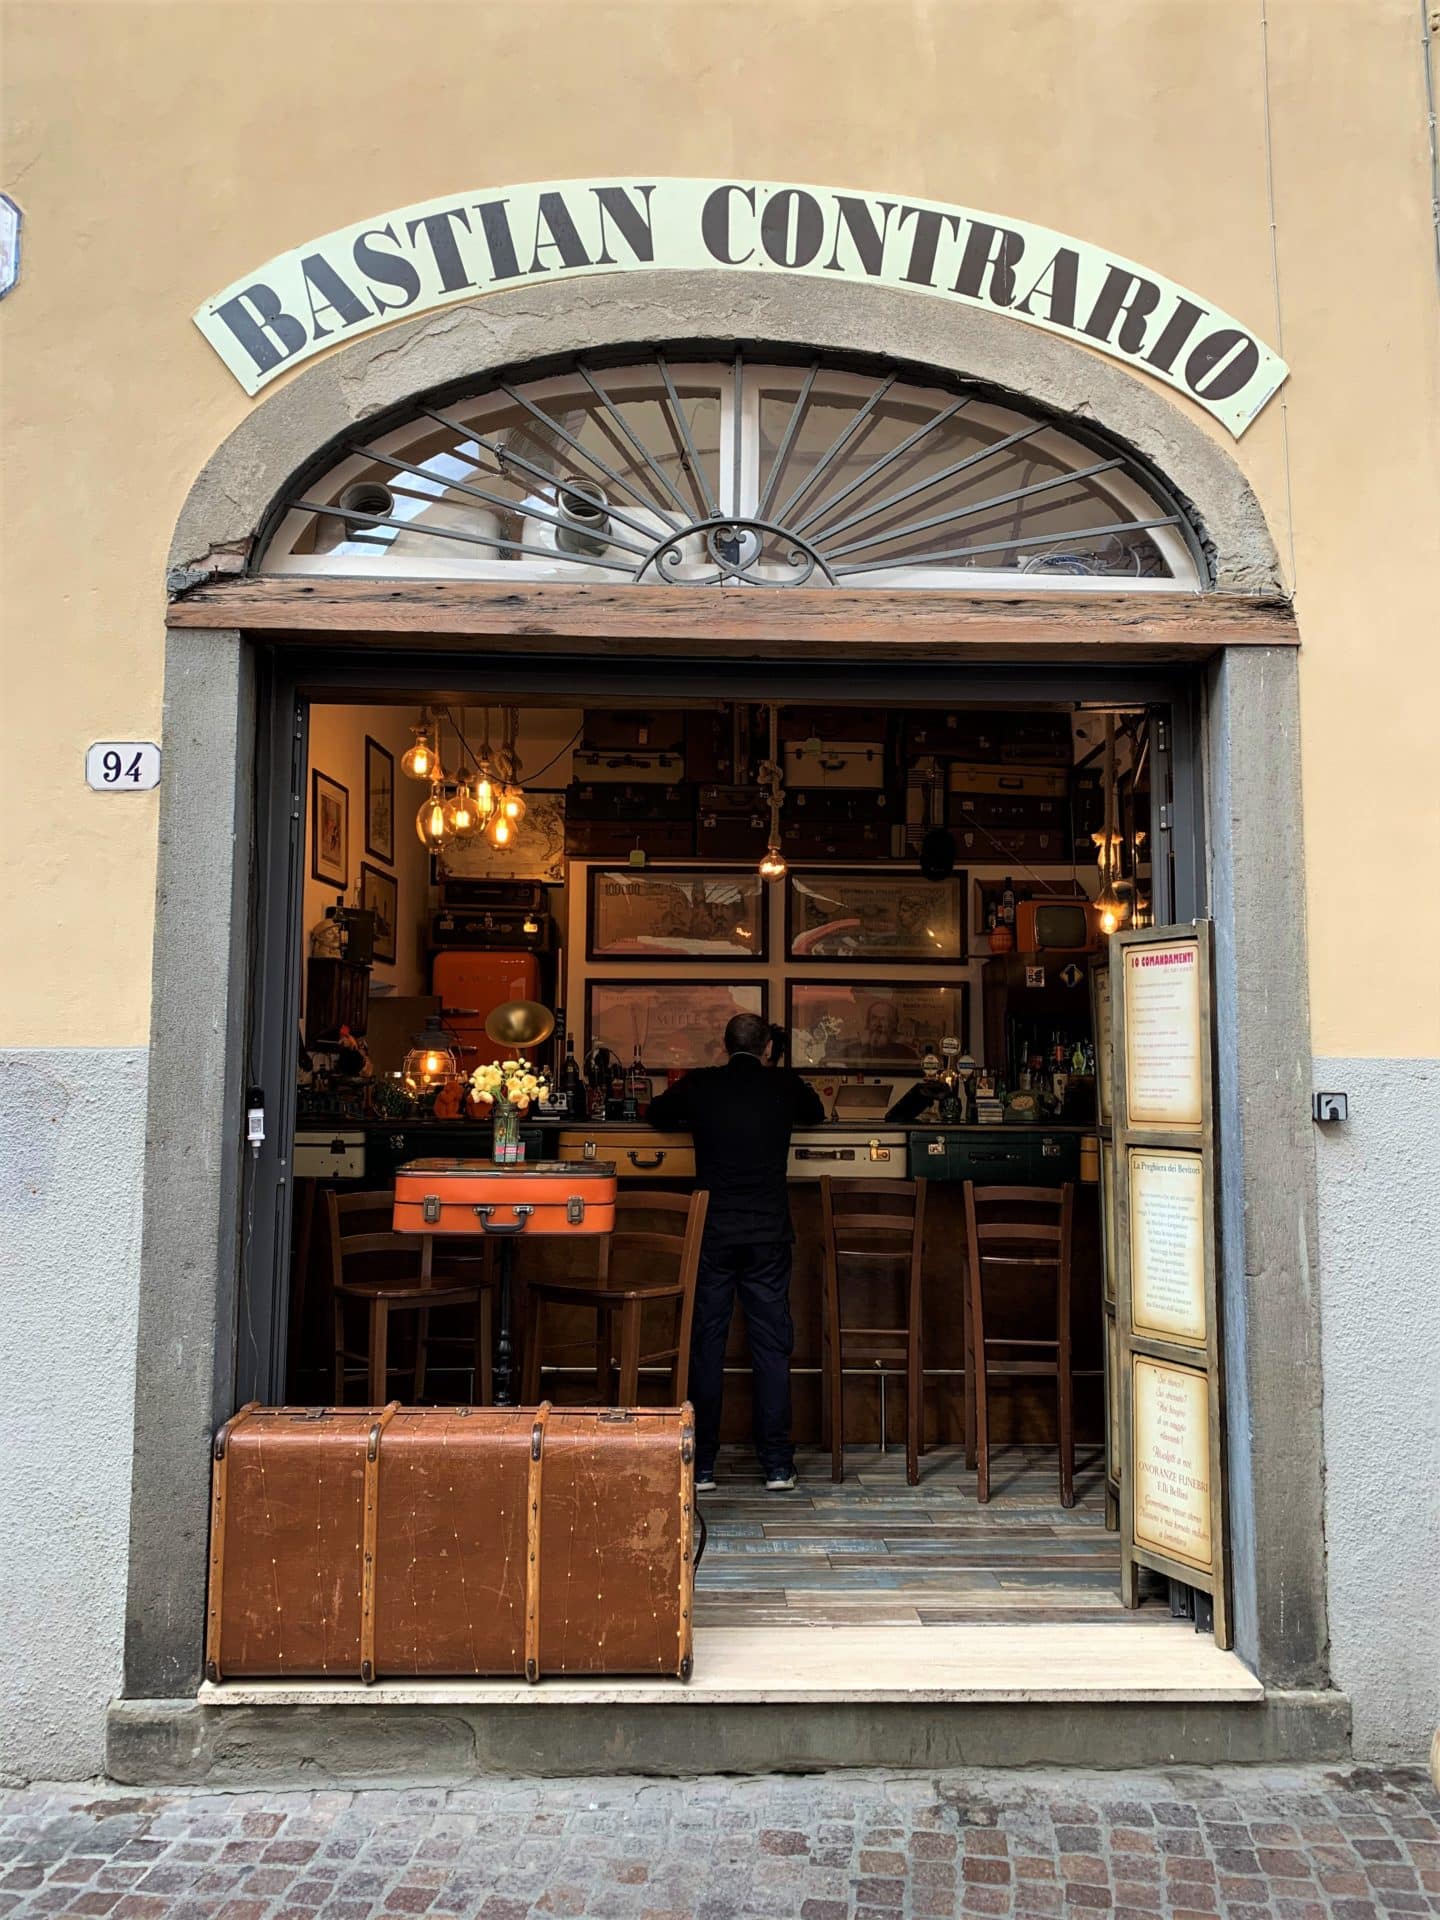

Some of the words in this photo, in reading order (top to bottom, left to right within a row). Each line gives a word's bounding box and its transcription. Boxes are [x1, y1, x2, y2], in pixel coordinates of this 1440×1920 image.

[209, 185, 657, 378] BASTIAN
[701, 184, 1260, 401] CONTRARIO
[102, 750, 143, 783] 94
[1141, 951, 1194, 968] COMANDAMENTI
[1138, 1461, 1177, 1483] ONORANZE
